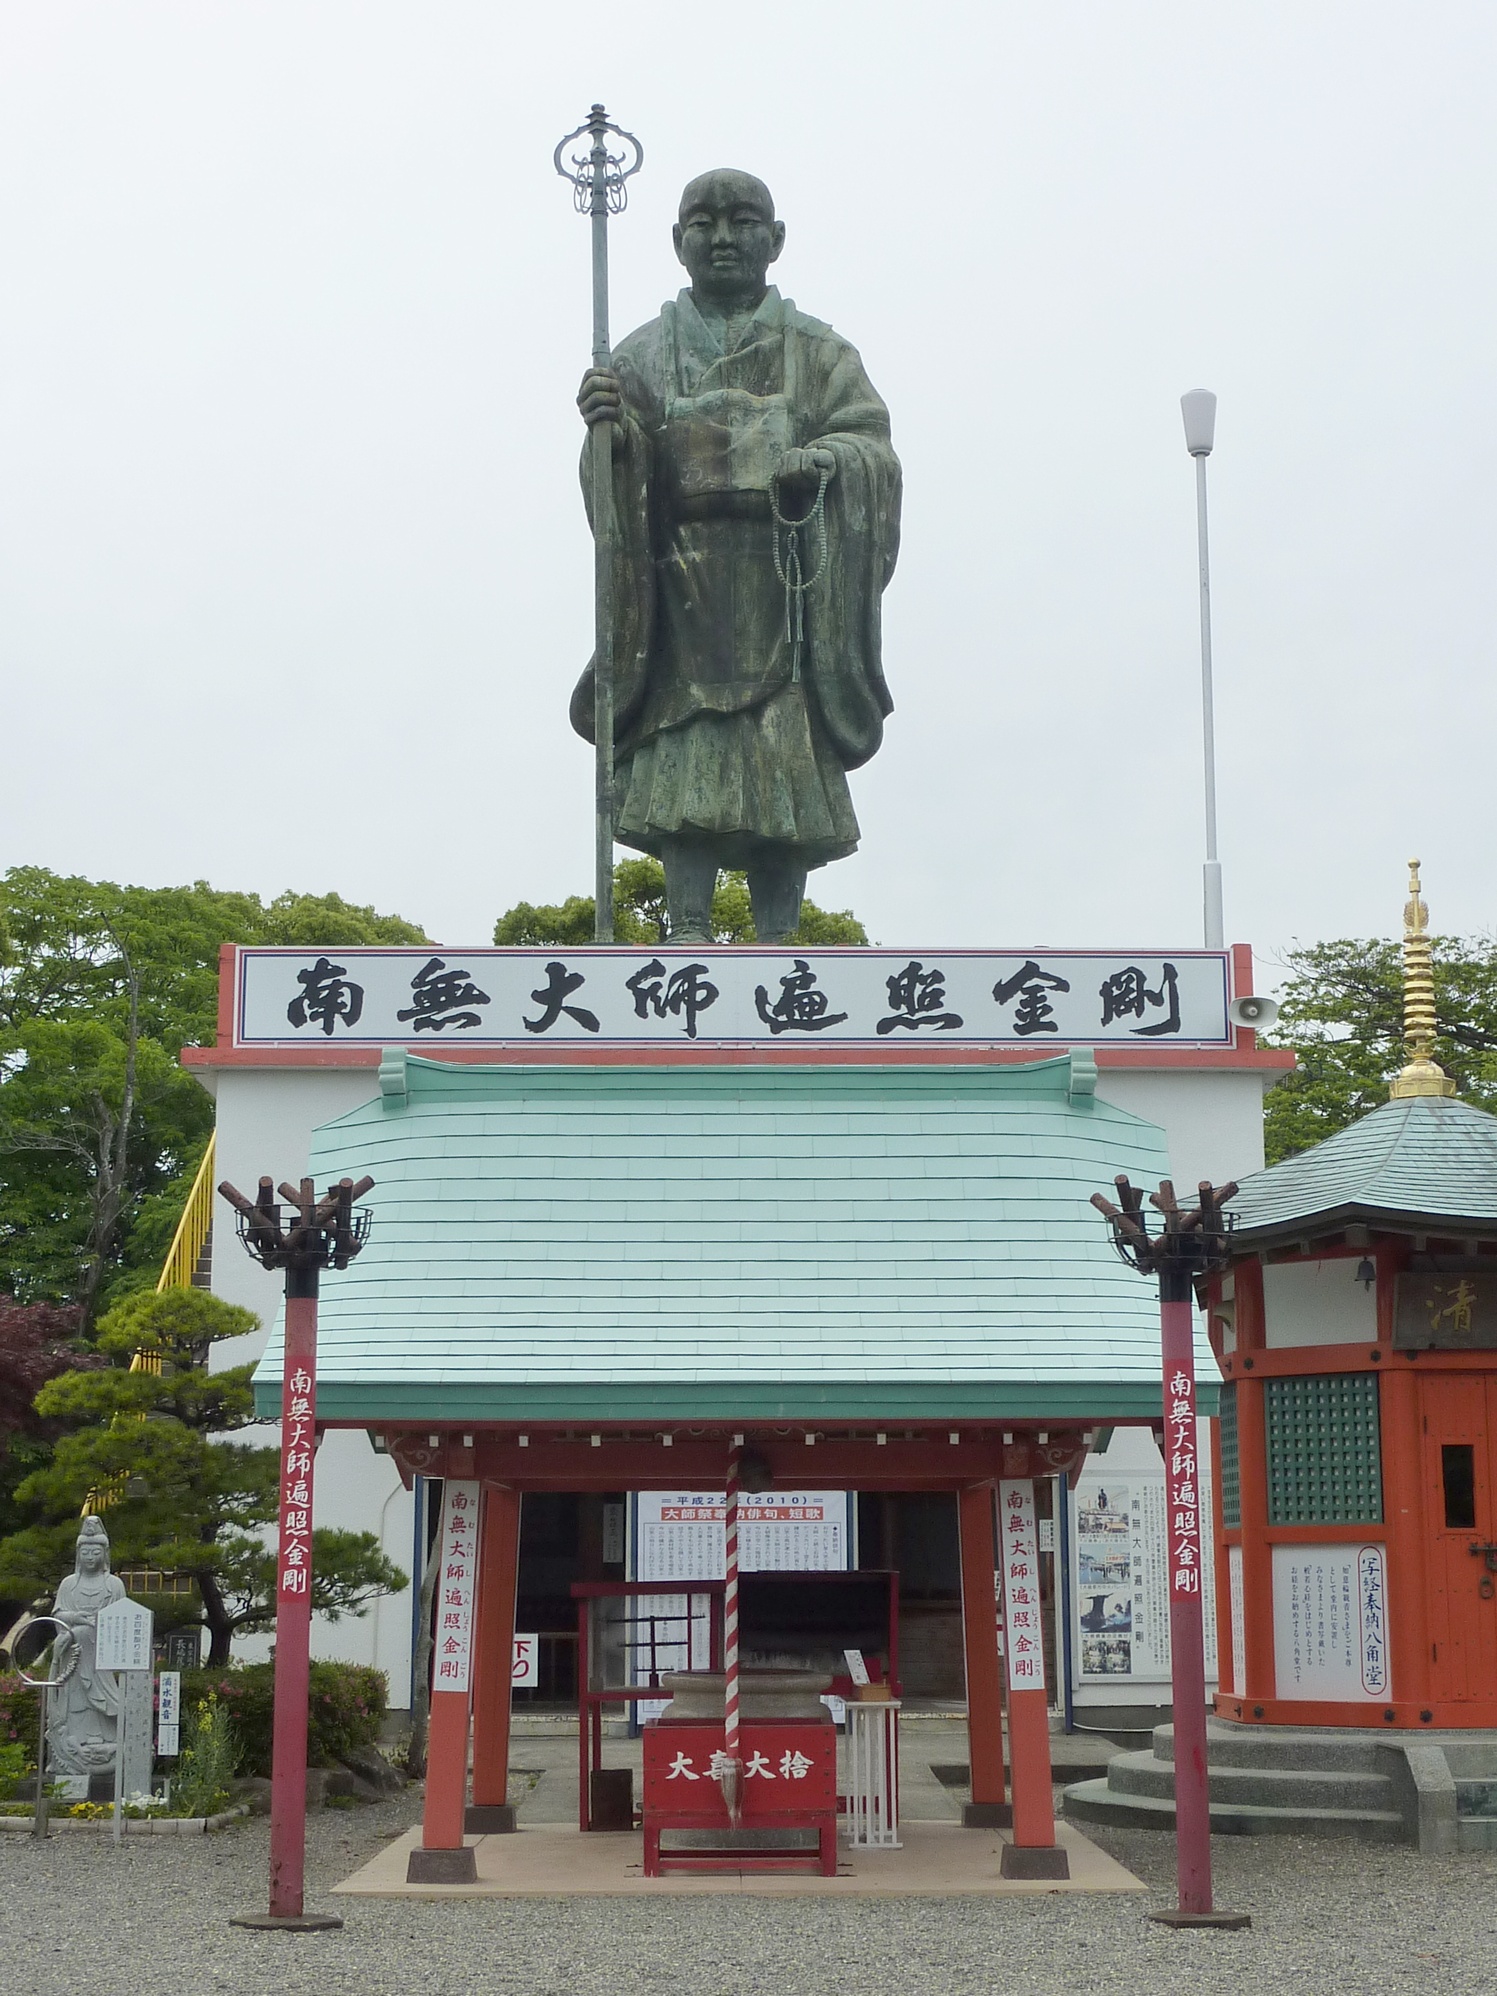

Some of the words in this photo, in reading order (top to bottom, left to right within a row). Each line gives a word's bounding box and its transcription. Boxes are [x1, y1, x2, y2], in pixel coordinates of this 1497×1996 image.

[286, 956, 1181, 1040] 南無大師遍照金剛
[1425, 1279, 1478, 1332] 清
[282, 1368, 313, 1594] 南無大師遍照金剛
[1168, 1370, 1199, 1593] 南無大師遍照金剛
[440, 1491, 468, 1679] 南無大師遍照金剛
[1007, 1490, 1034, 1677] 南無大師遍照金剛
[1360, 1557, 1382, 1686] 写経奉納八角堂
